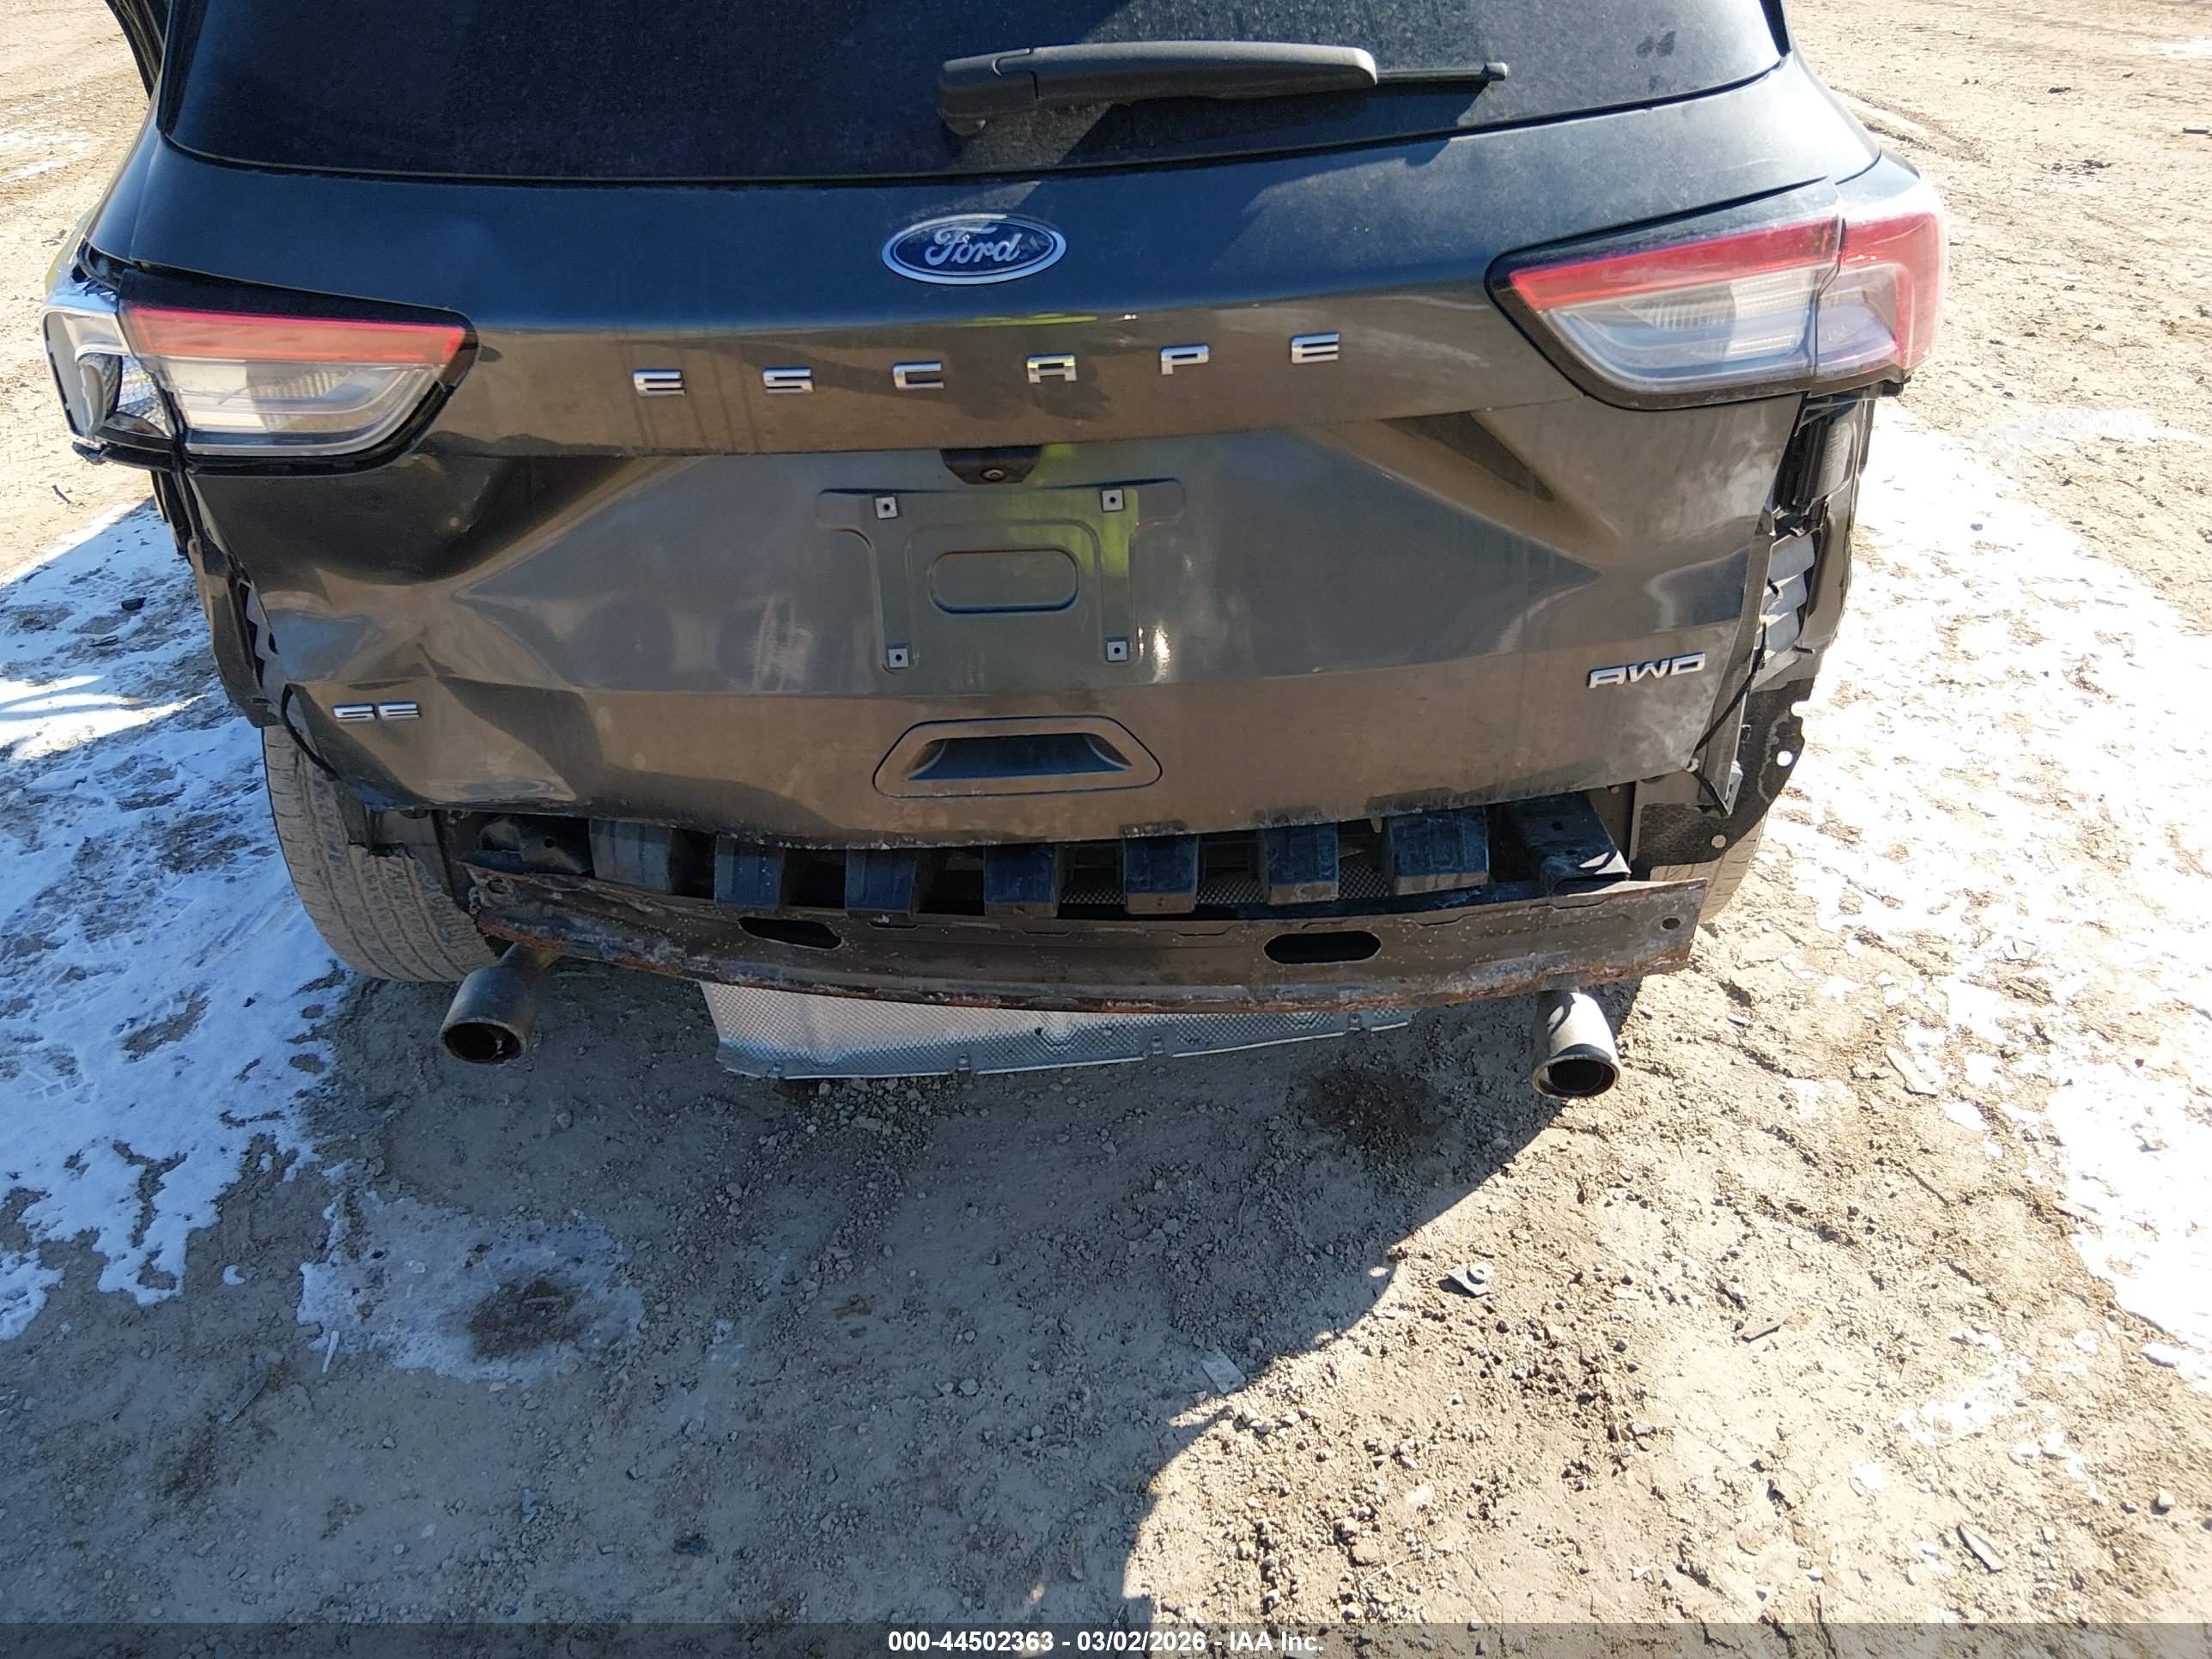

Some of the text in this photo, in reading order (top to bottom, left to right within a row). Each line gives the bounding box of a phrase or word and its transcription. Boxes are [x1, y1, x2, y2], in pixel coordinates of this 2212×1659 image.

[925, 226, 1021, 266] Ford
[632, 331, 1340, 397] ESCAPE
[1588, 653, 1706, 690] AWD
[332, 702, 420, 722] SE
